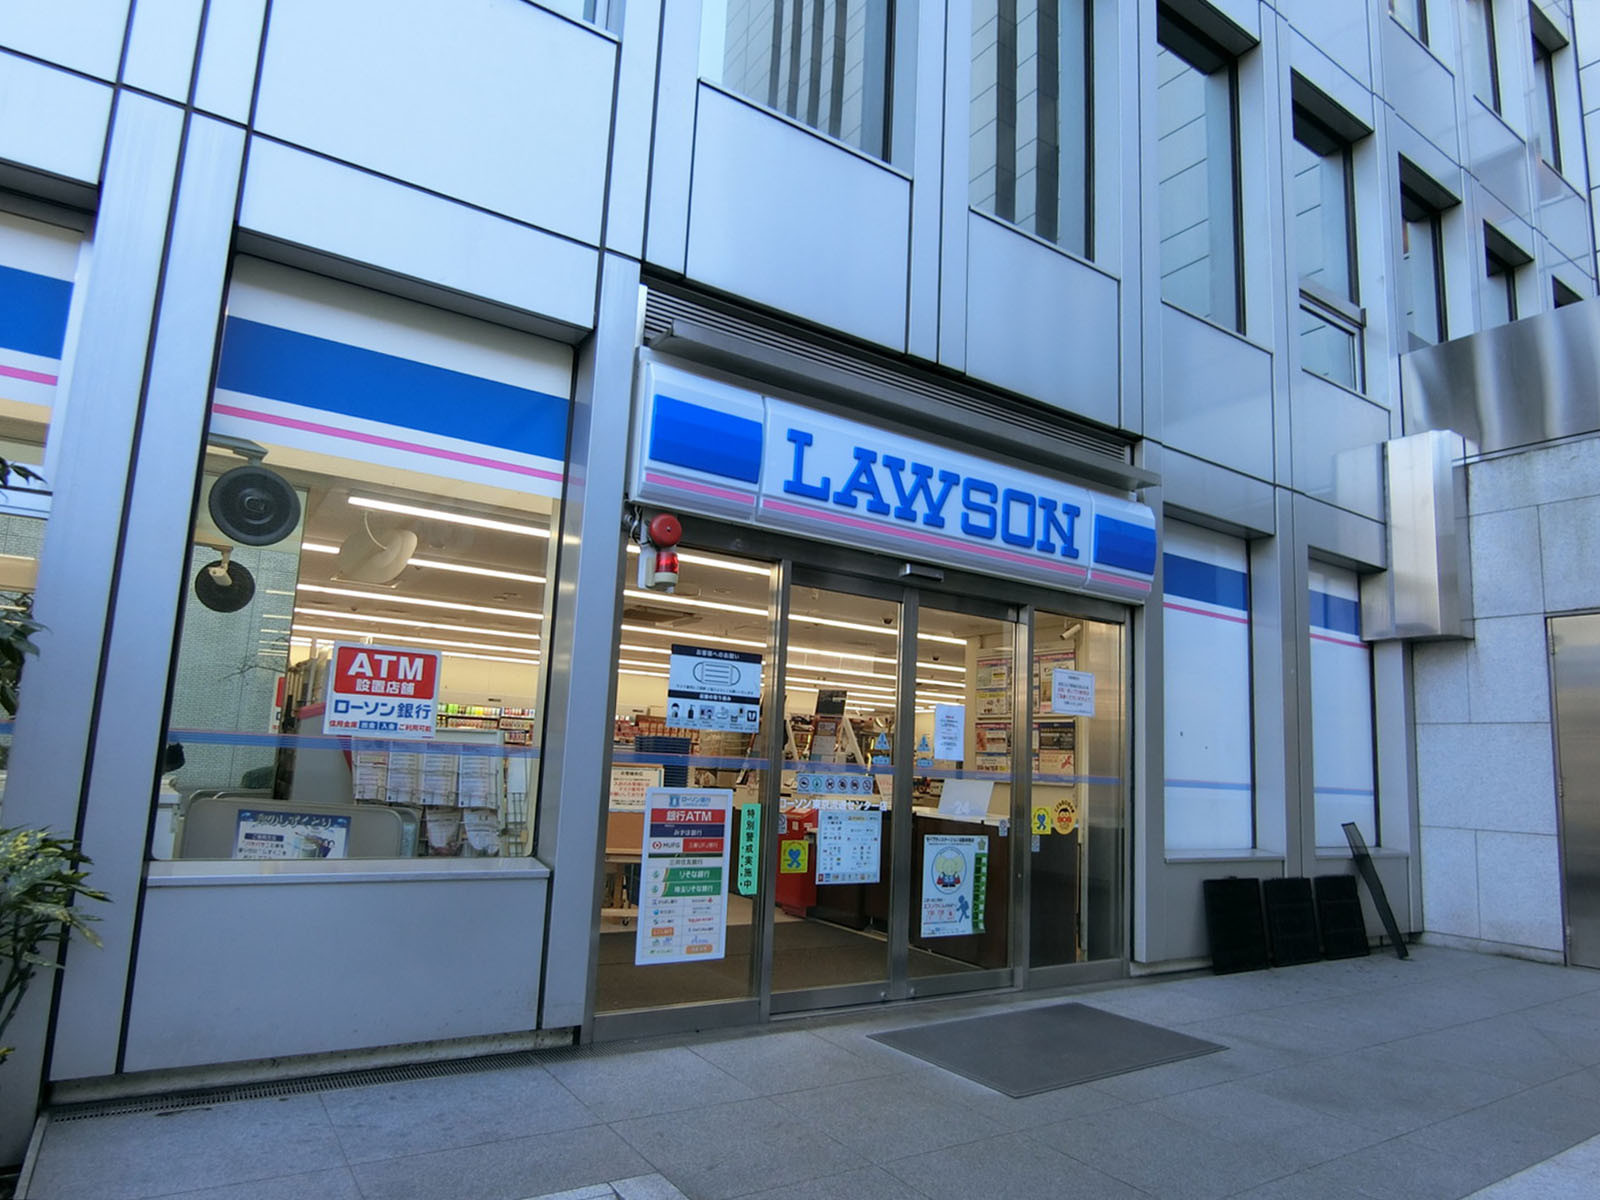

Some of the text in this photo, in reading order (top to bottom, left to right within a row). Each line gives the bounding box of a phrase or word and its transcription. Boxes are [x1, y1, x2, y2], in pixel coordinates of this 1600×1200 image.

[783, 428, 1081, 560] LAWSON
[347, 652, 424, 681] ATM
[355, 678, 415, 696] 設置店舗
[334, 699, 432, 720] ローソン銀行
[666, 810, 713, 822] 銀行ATM
[673, 827, 703, 836] みずほ銀行
[669, 858, 704, 866] 三井住友銀行
[679, 869, 711, 880] りそな銀行
